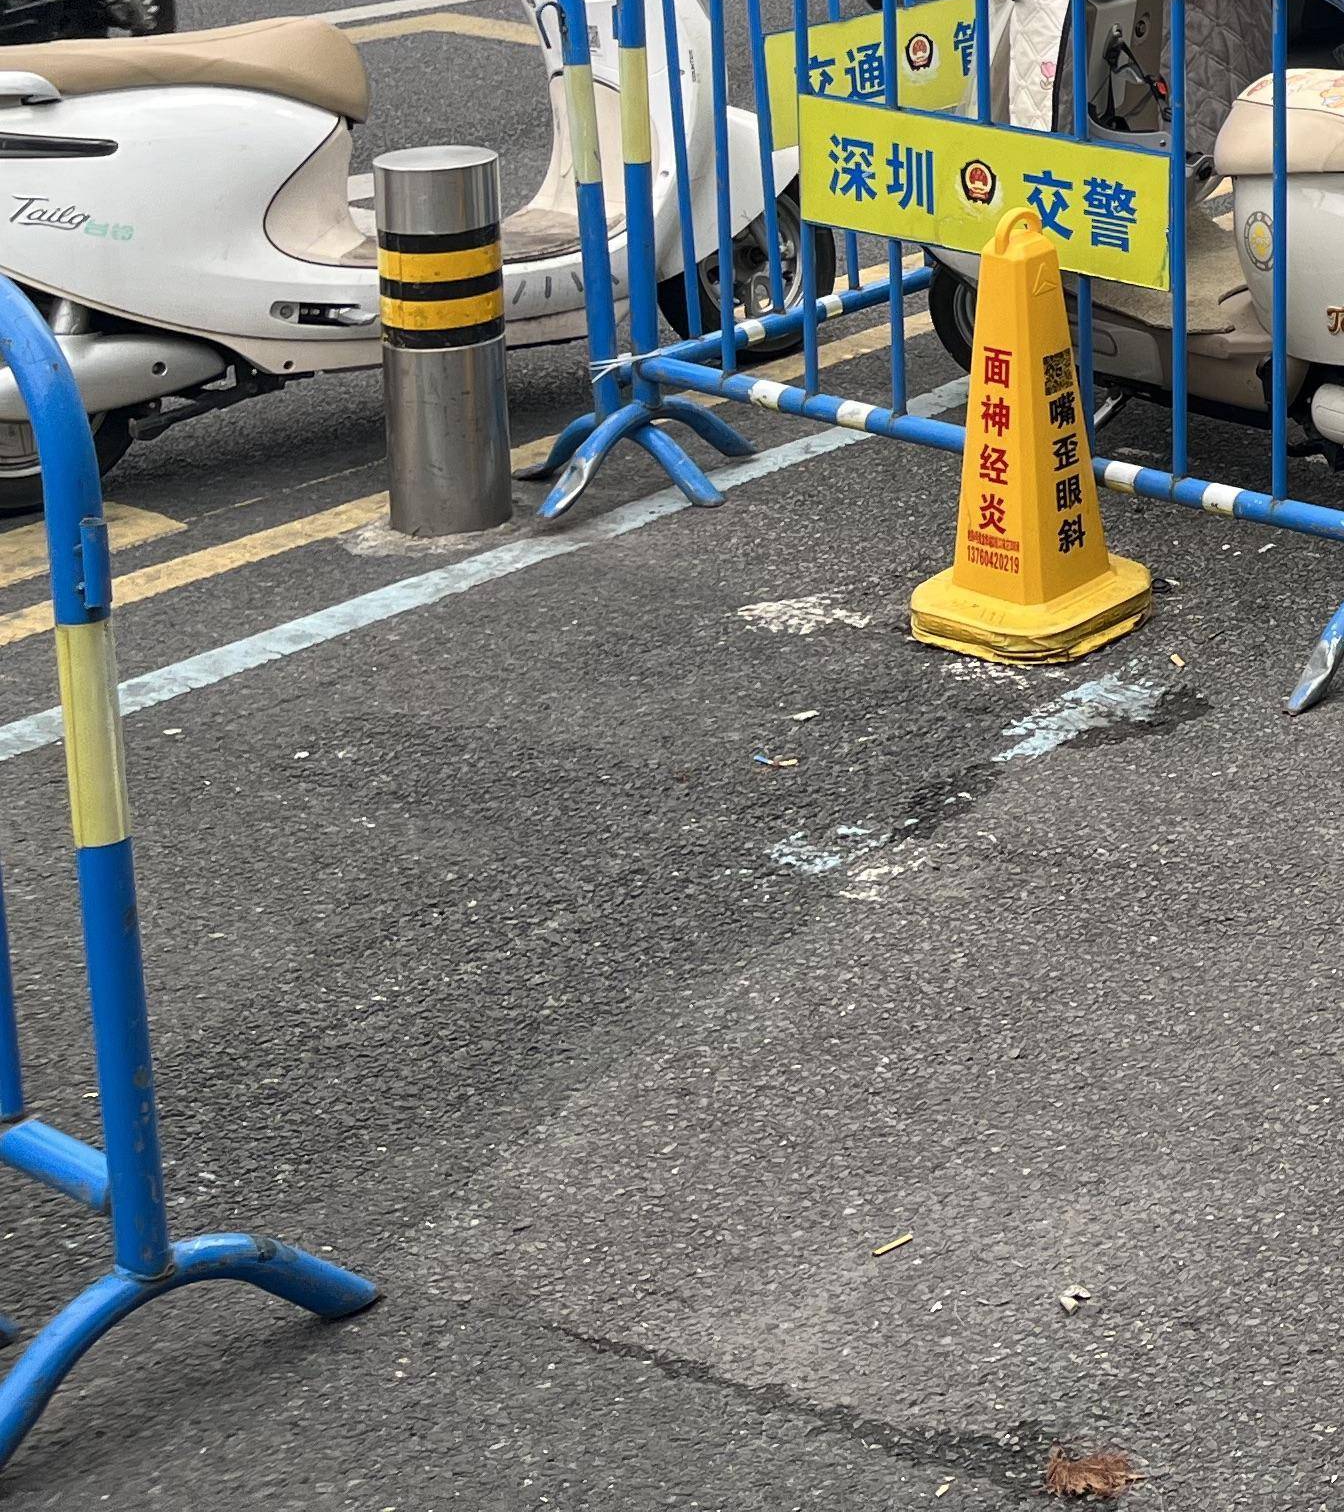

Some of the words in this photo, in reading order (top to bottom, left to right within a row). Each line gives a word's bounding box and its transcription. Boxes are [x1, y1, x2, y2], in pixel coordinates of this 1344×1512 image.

[9, 195, 91, 230] Tailg
[828, 133, 935, 215] 深圳
[1022, 169, 1138, 253] 交警
[978, 346, 1013, 535] 面神经炎
[1048, 391, 1086, 554] 嘴歪眼斜
[967, 545, 1020, 575] 13760420219
